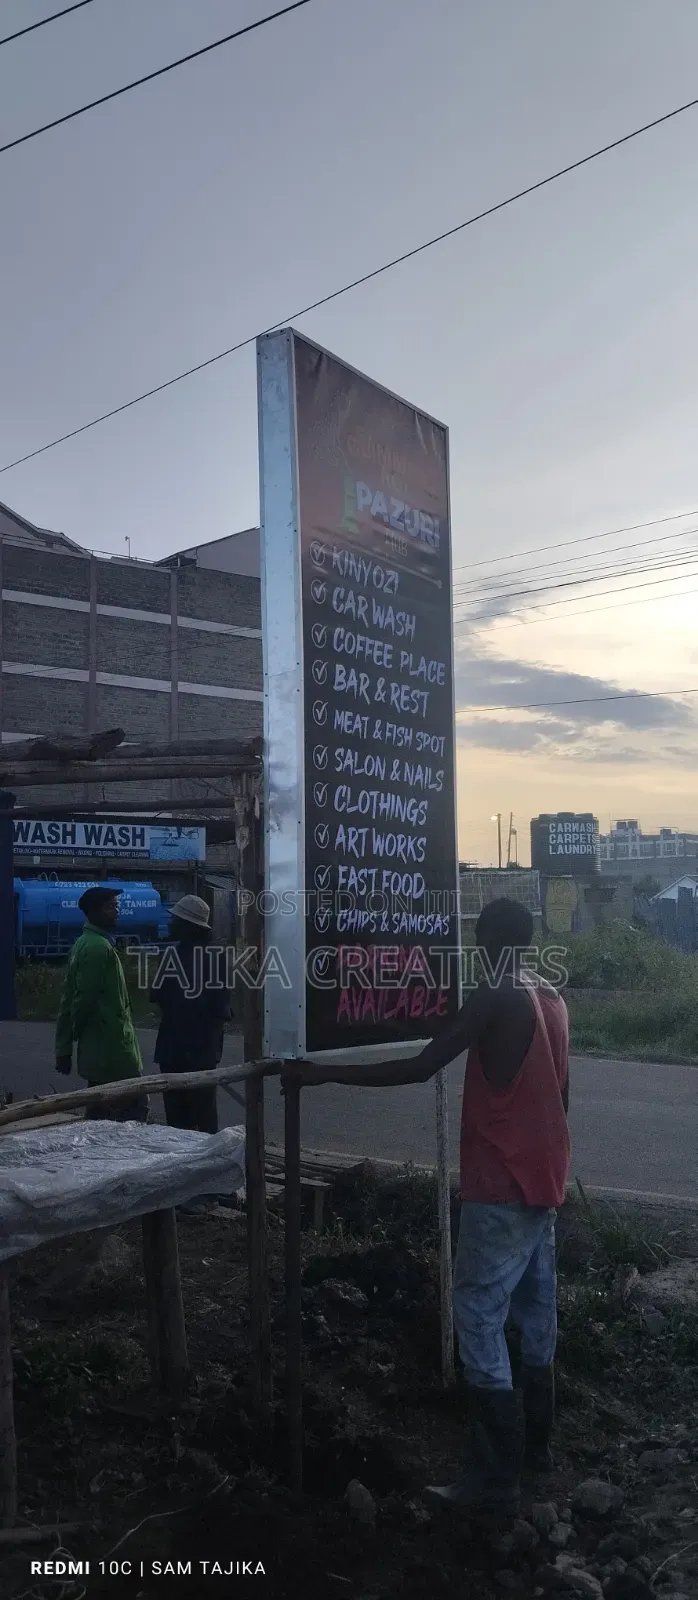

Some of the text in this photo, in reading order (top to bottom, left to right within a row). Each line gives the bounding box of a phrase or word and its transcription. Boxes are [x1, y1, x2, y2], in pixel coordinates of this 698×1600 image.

[355, 480, 440, 547] PAZURI
[332, 546, 399, 595] KINYOZI
[332, 587, 416, 642] CAR WASH
[333, 627, 446, 685] COFFEE PLACE
[333, 663, 430, 718] BAR & REST
[334, 709, 446, 757] MEAT & FISH SPOT
[334, 747, 445, 792] SALON & NAILS
[333, 784, 428, 827] CLOTHINGS
[12, 821, 145, 847] WASH WASH
[334, 824, 427, 864] ART WORKS
[548, 822, 596, 833] CARWASH
[548, 833, 597, 844] CARPETS
[548, 844, 597, 855] LAUNDRY
[337, 864, 425, 899] FAST FOOD
[124, 900, 157, 908] TANKER
[336, 909, 450, 937] CHIPS & SAMOSAS
[336, 985, 448, 1025] AVAILABLE
